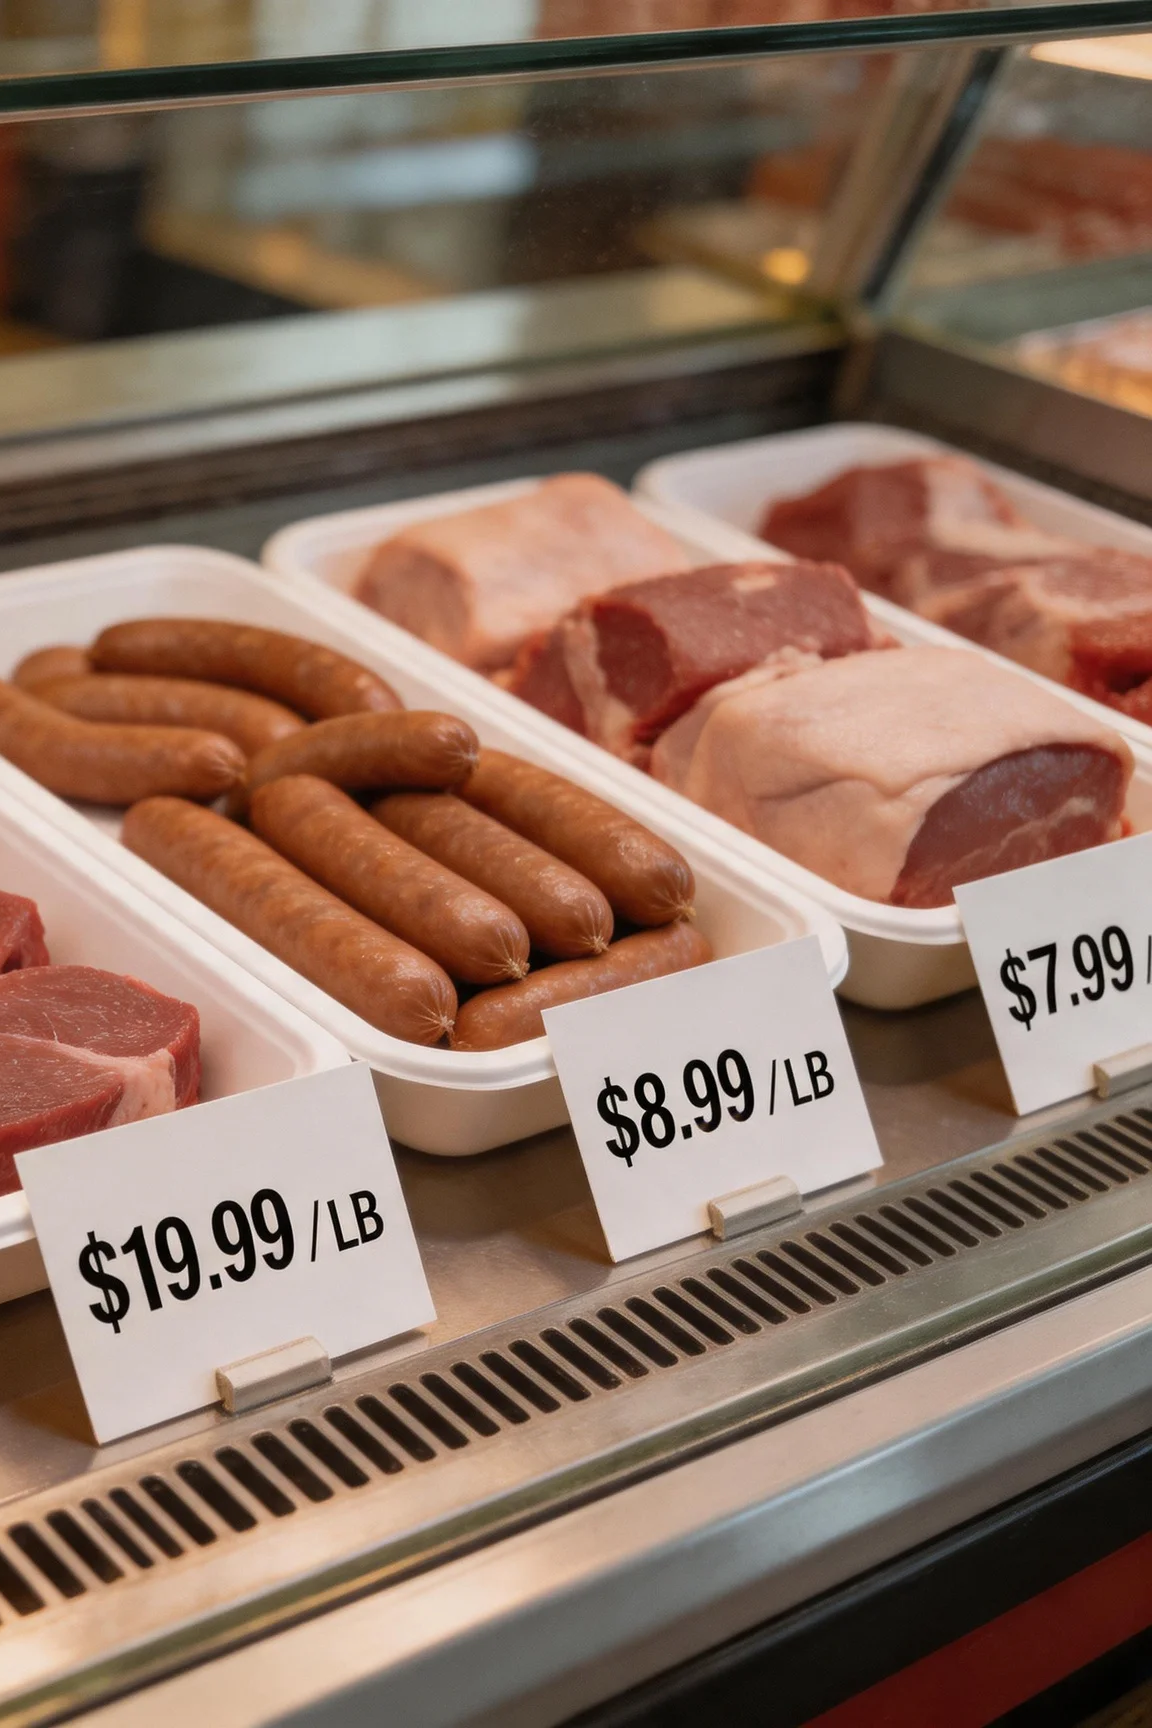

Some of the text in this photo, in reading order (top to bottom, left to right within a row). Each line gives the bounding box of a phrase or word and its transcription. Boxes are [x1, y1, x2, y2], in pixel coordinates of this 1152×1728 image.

[999, 925, 1134, 1032] $7.99
[596, 1048, 755, 1168] $8.99
[78, 1188, 295, 1335] $19.99
